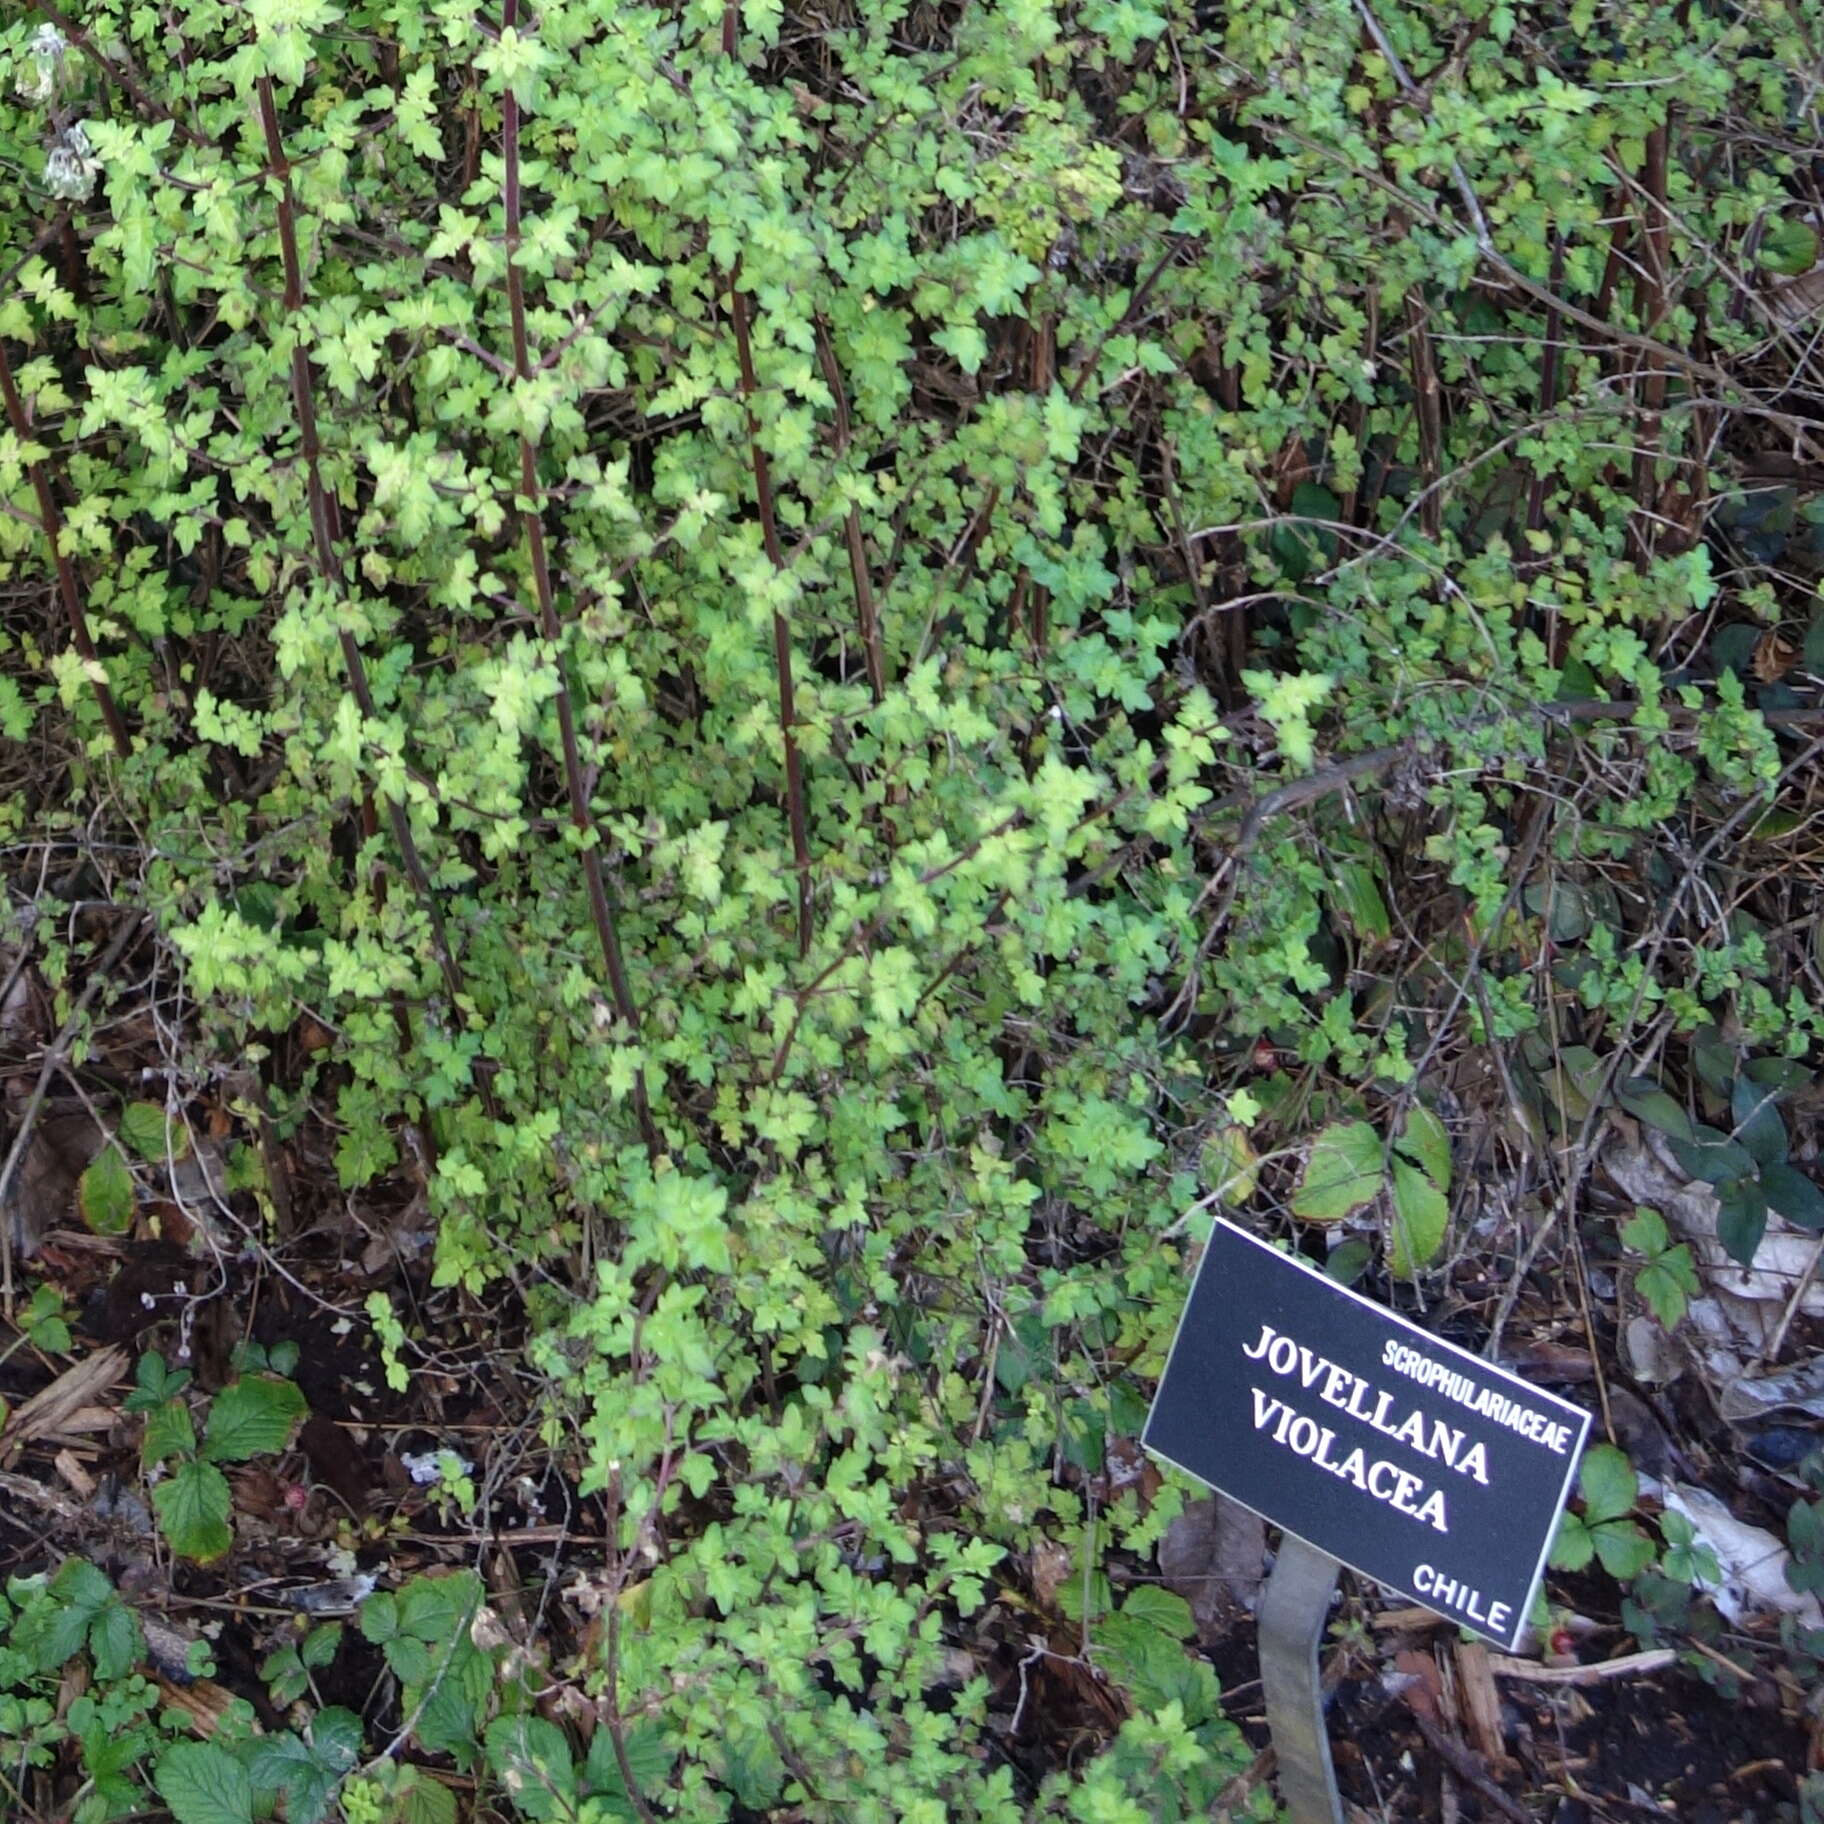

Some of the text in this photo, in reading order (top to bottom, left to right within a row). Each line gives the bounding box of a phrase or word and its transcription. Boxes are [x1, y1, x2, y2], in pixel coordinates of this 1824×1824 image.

[1242, 1325, 1490, 1485] JOVELLANA
[1250, 1387, 1449, 1532] VIOLACEA
[1382, 1339, 1572, 1454] SCROPHULARIACEAE
[1413, 1564, 1512, 1633] CHILE
